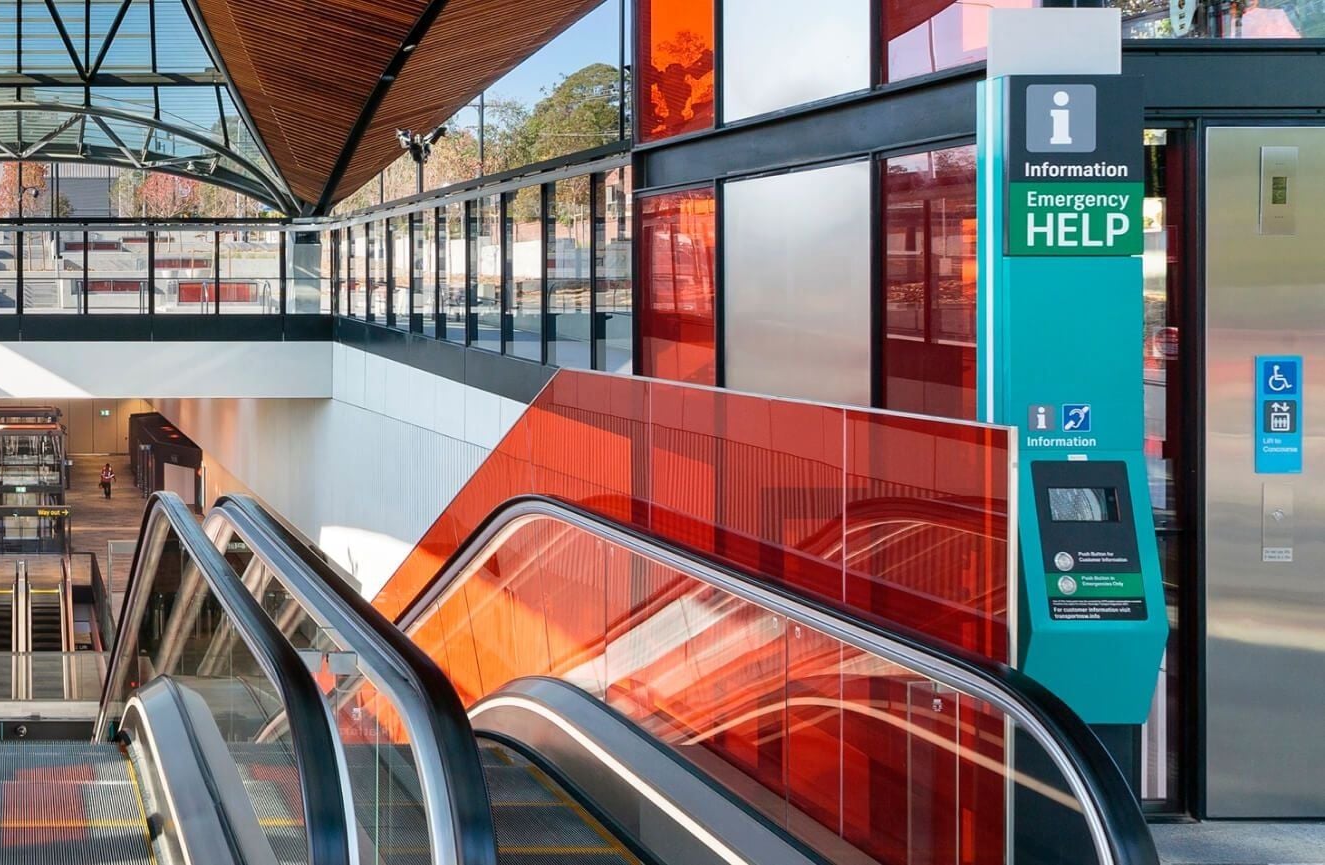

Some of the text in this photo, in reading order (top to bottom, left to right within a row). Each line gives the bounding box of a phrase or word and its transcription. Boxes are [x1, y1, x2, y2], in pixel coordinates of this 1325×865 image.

[1025, 162, 1128, 177] Information
[1027, 191, 1130, 211] Emergency
[1027, 213, 1130, 247] HELP
[1027, 436, 1097, 447] Information
